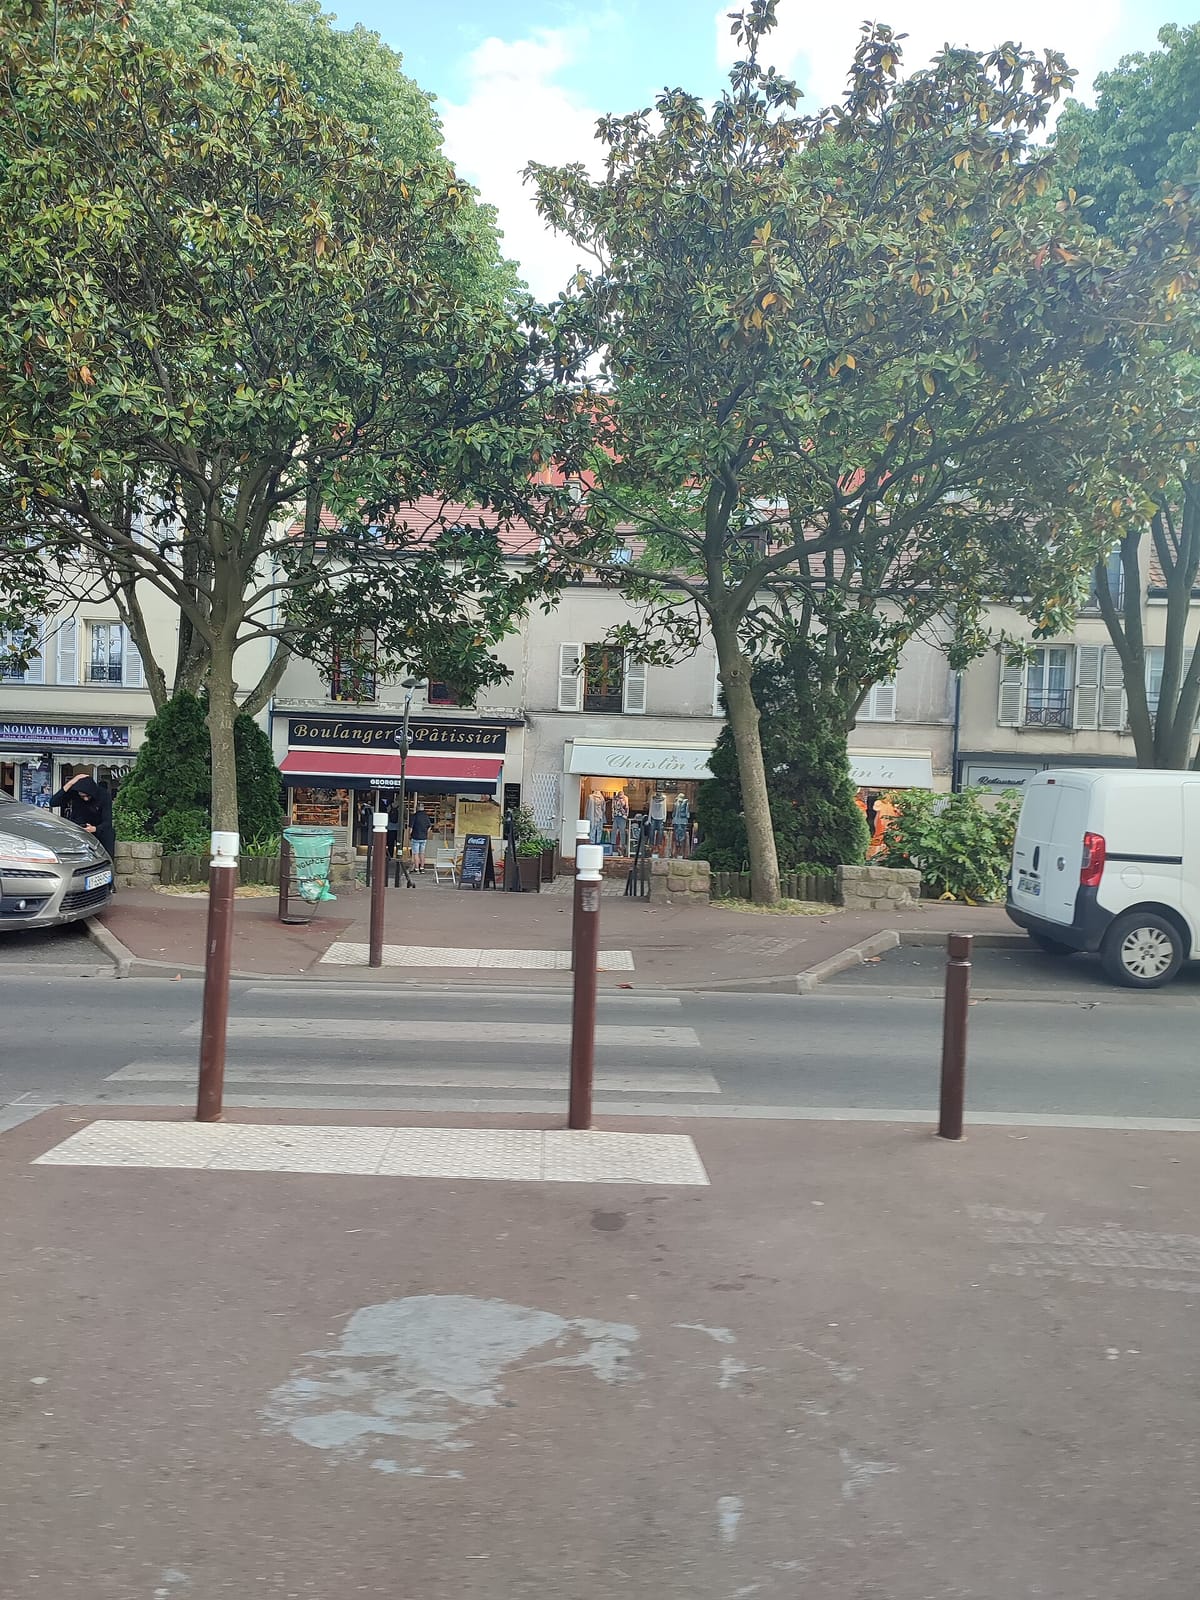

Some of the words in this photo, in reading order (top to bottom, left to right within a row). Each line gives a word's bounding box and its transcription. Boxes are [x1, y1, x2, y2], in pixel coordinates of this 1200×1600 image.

[3, 724, 59, 735] NOUVEAU
[63, 727, 94, 737] LOOK
[294, 724, 394, 744] Boulanger
[414, 726, 501, 744] Pâtissier
[977, 775, 1027, 786] Restaurant
